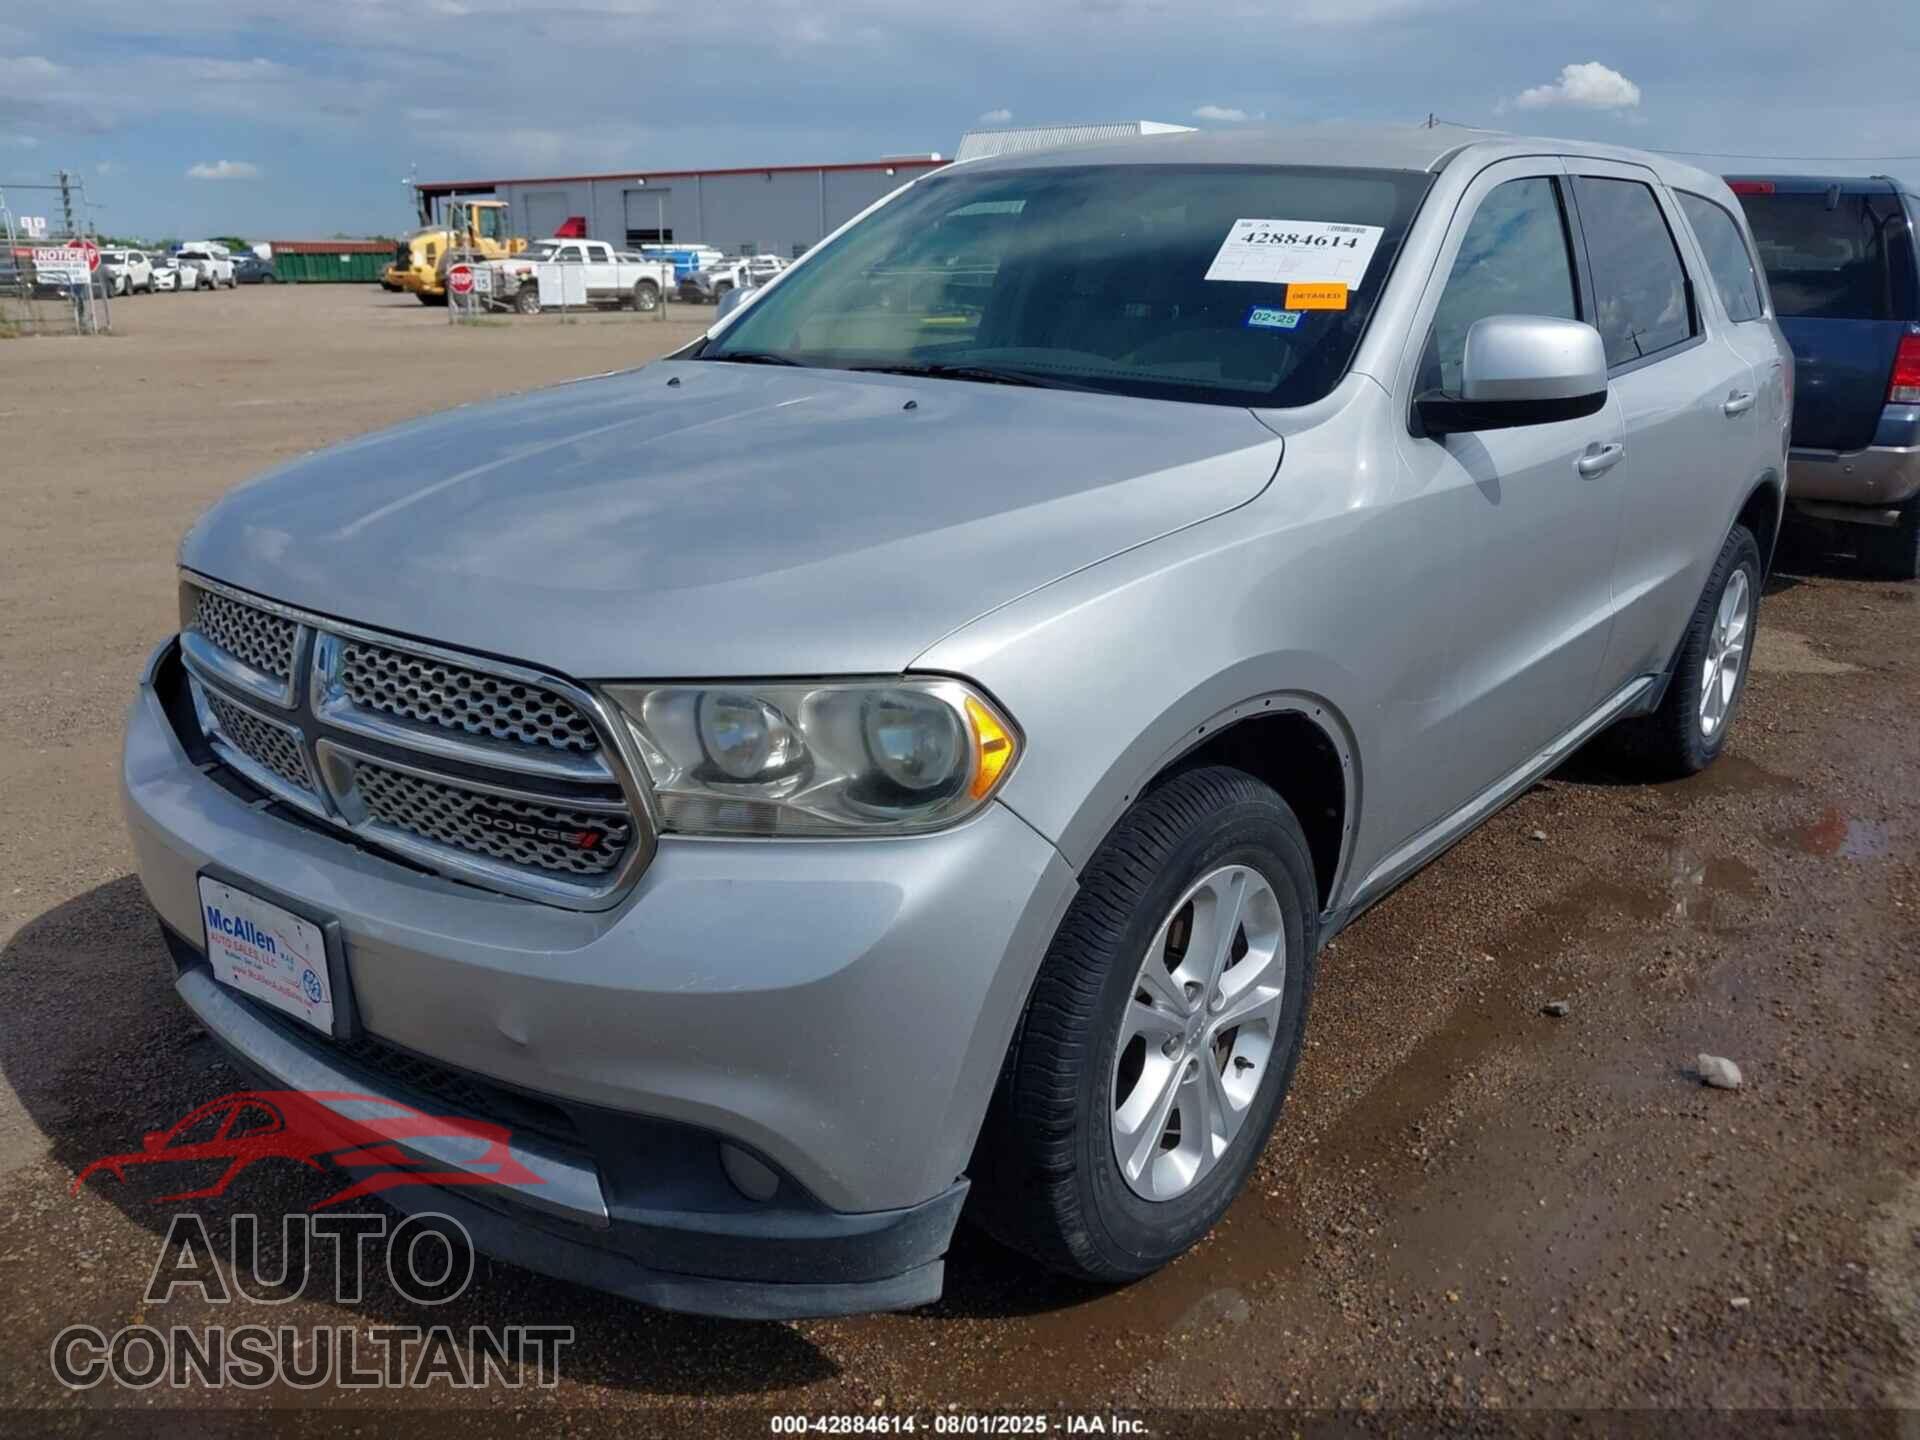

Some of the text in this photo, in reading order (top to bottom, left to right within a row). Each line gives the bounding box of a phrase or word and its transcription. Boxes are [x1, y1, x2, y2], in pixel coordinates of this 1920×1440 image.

[1241, 232, 1358, 248] 42884614
[38, 249, 88, 261] NOTICE
[450, 272, 472, 284] STOP
[1291, 292, 1342, 300] DETAILED
[472, 812, 579, 844] DODGE
[207, 906, 276, 954] McAllen
[208, 931, 232, 949] AUTO
